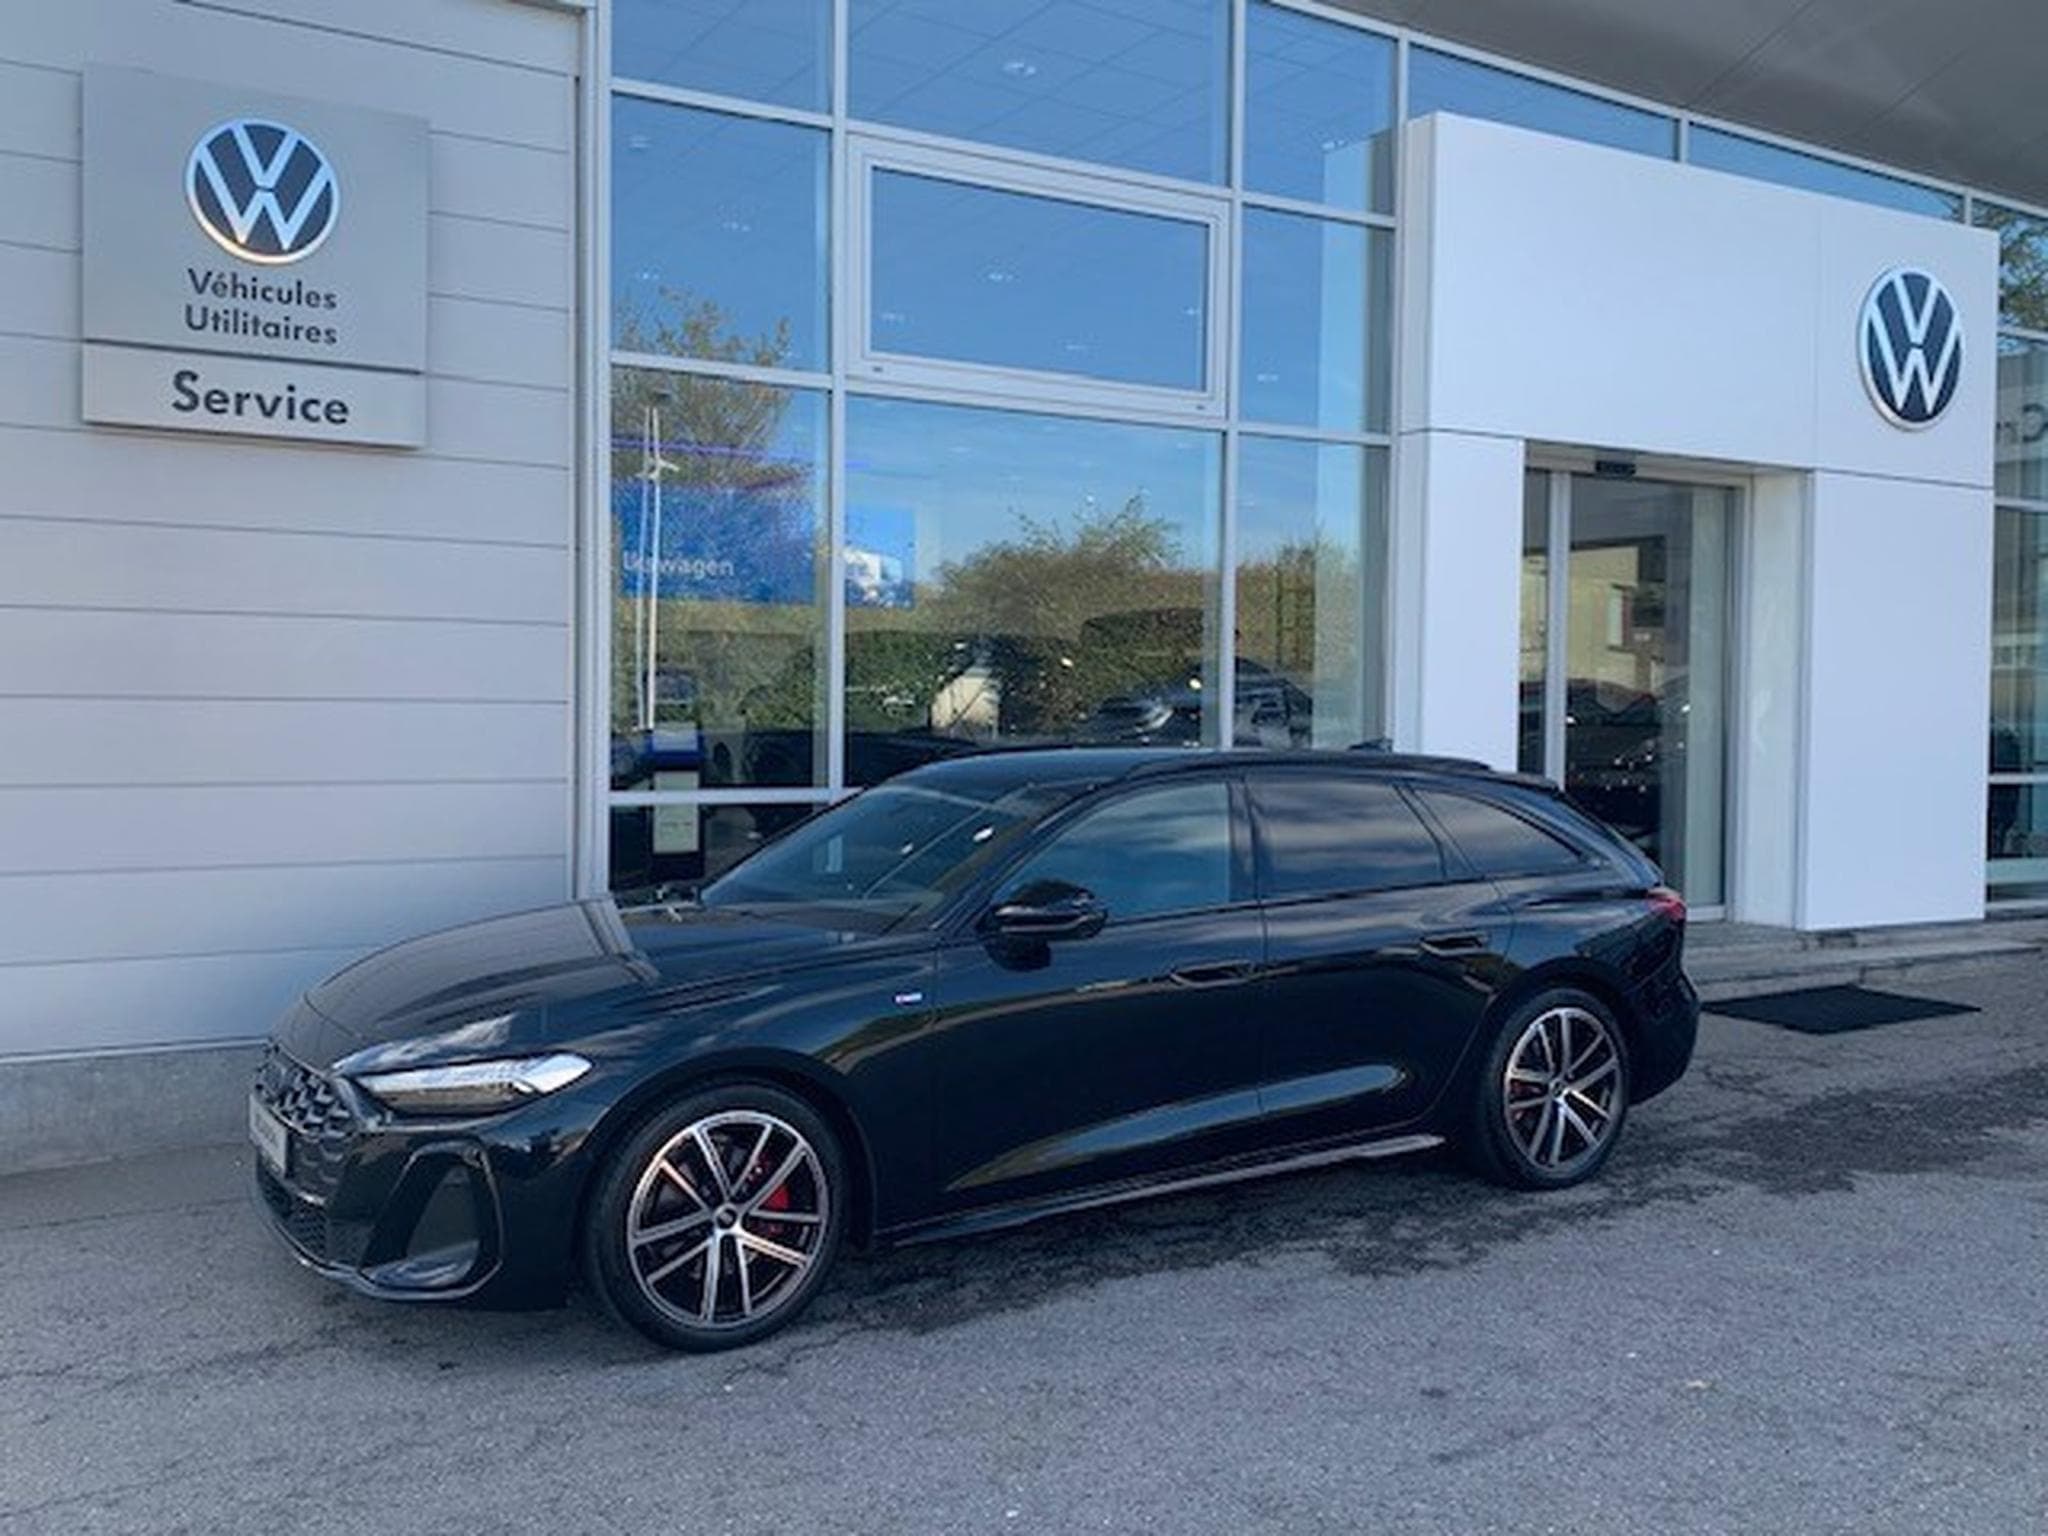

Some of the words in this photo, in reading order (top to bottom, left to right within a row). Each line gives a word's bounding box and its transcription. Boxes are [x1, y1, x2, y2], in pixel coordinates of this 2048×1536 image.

[185, 118, 340, 265] VW
[187, 267, 338, 310] Véhicules
[184, 304, 338, 345] Utilitaires
[1858, 266, 1966, 432] VW
[171, 369, 350, 425] Service
